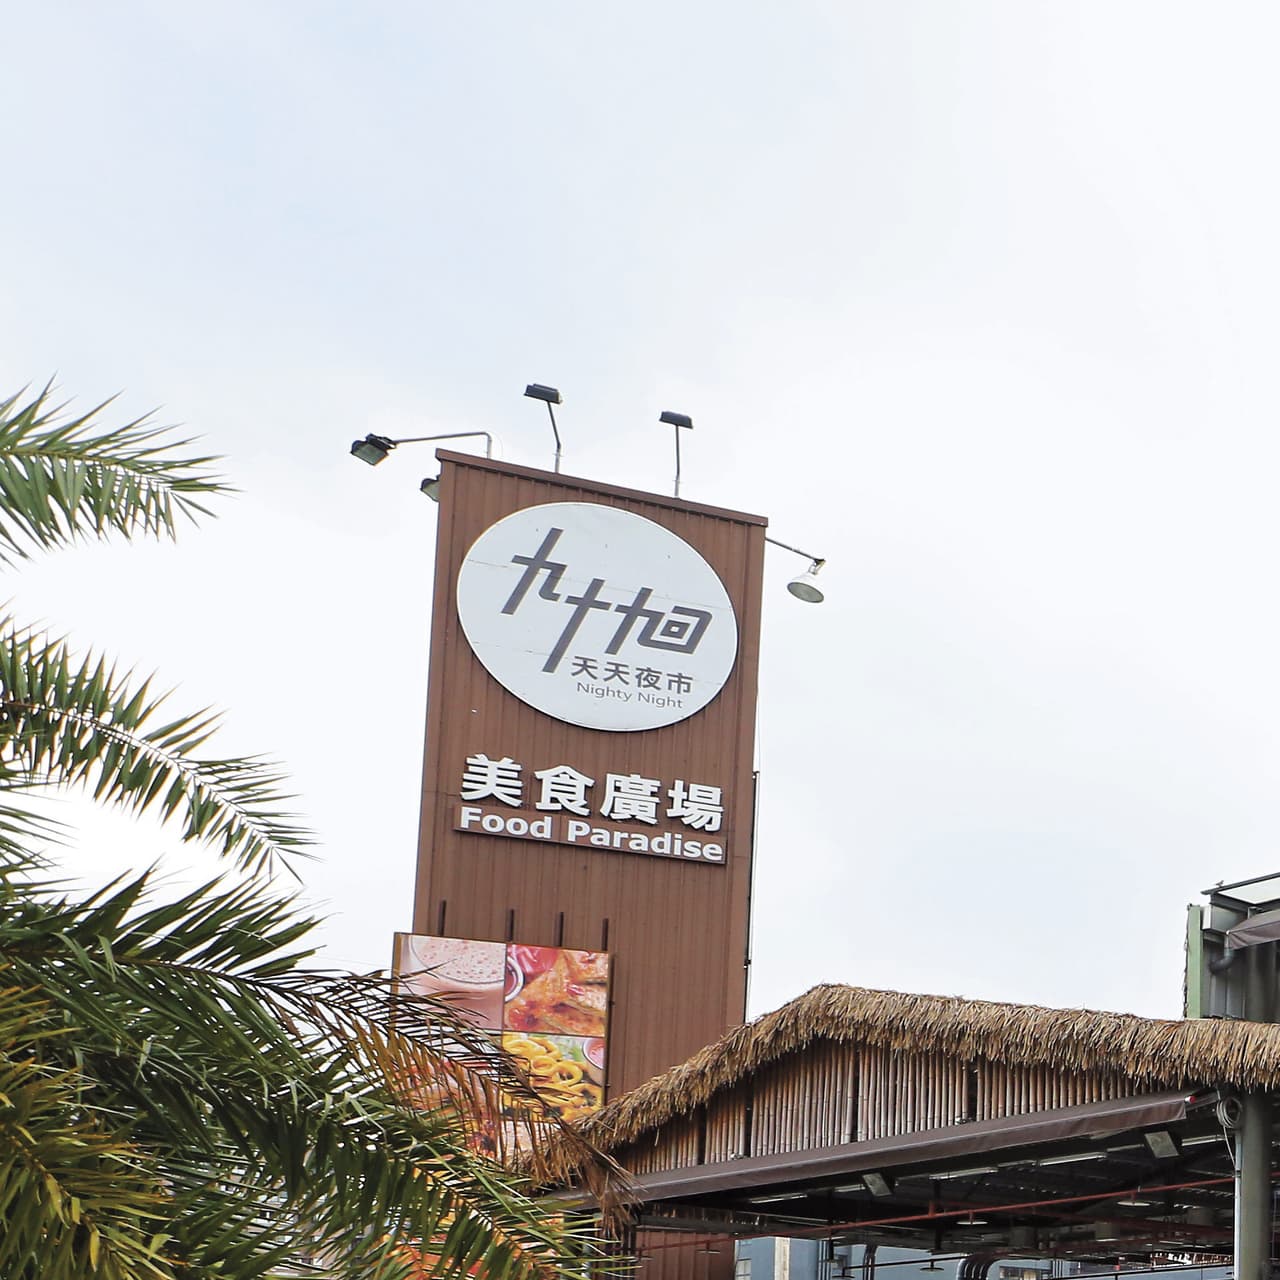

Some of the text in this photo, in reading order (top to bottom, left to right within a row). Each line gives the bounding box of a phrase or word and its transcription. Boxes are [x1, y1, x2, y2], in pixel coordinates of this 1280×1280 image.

[571, 656, 694, 695] 天天夜市
[577, 682, 684, 709] Nighty Night
[459, 753, 725, 832] 美食廣場
[459, 808, 724, 862] Food Paradise
